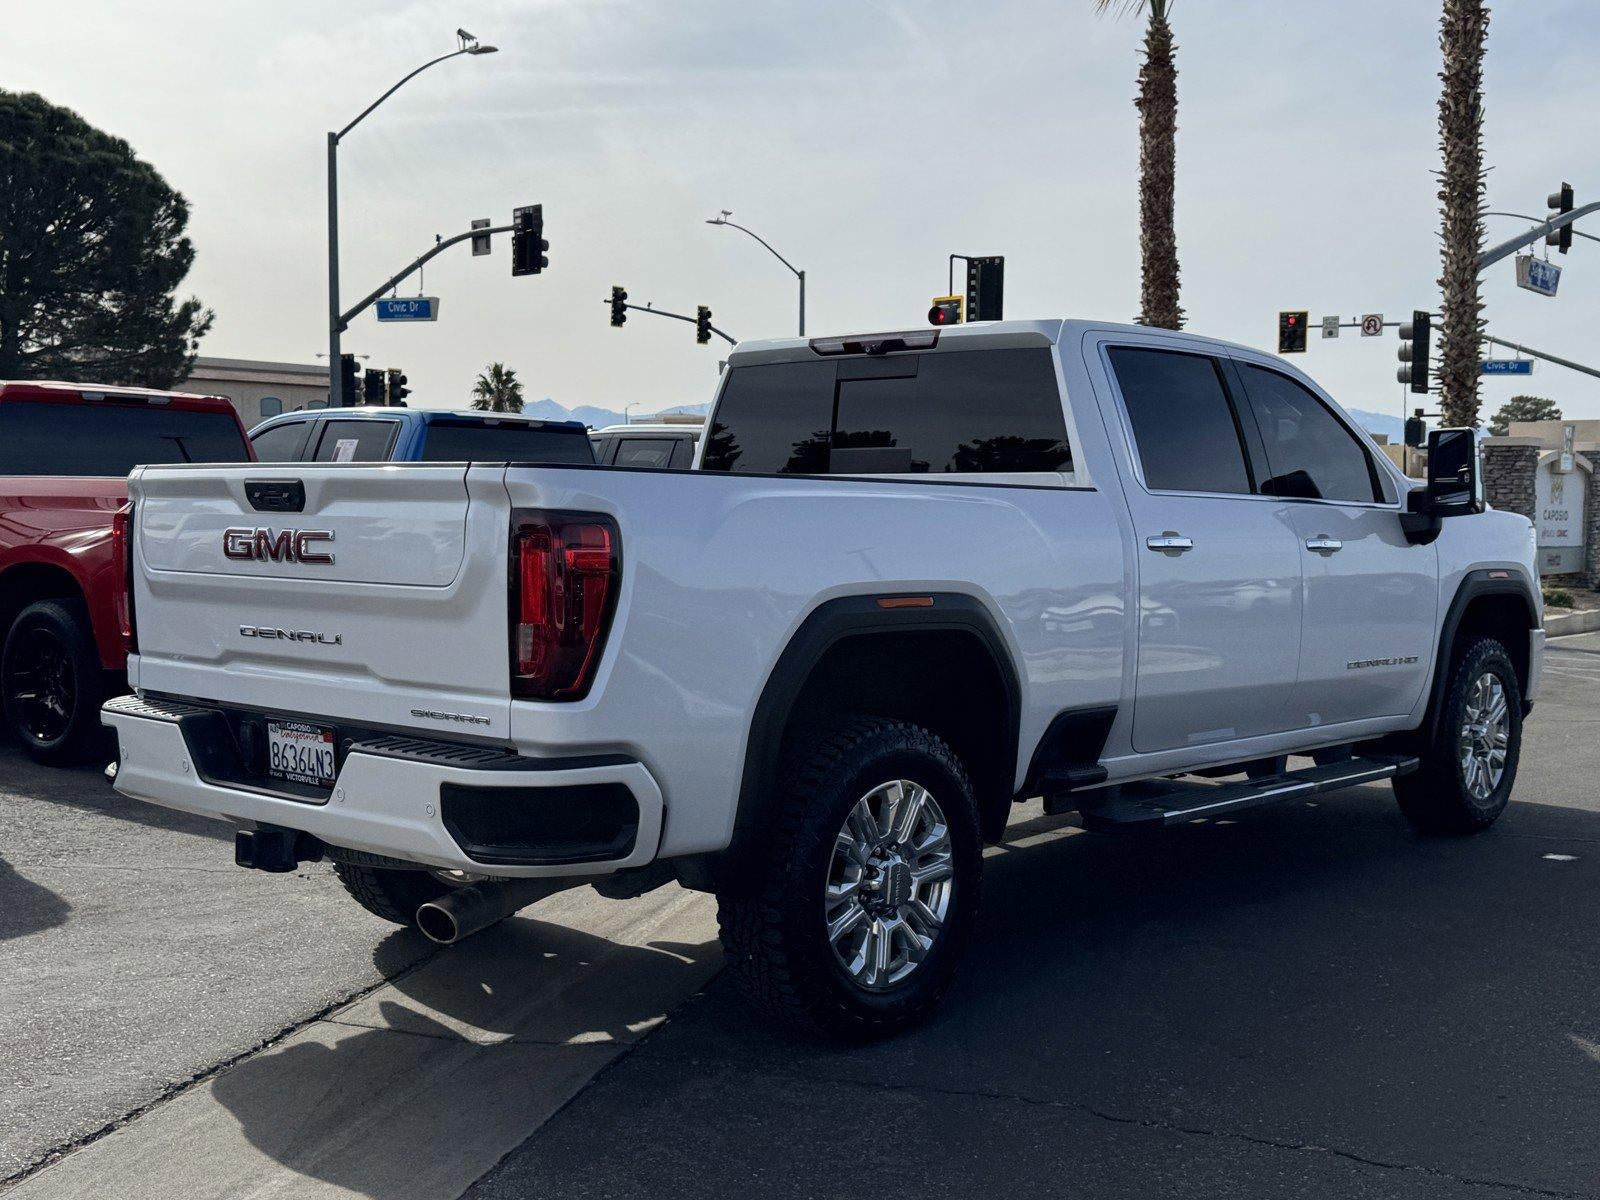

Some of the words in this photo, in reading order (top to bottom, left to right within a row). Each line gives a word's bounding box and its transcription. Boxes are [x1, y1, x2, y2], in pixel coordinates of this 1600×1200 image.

[388, 301, 407, 312] Civic
[409, 301, 419, 312] Dr
[1486, 361, 1506, 370] Civic
[1508, 361, 1519, 370] Dr
[223, 526, 336, 565] GMC
[239, 624, 342, 646] DENALI
[410, 708, 491, 726] SIERRA
[286, 722, 311, 732] CAPOSIO
[271, 741, 334, 778] 86364N3
[286, 772, 319, 785] VICTORVILLE
